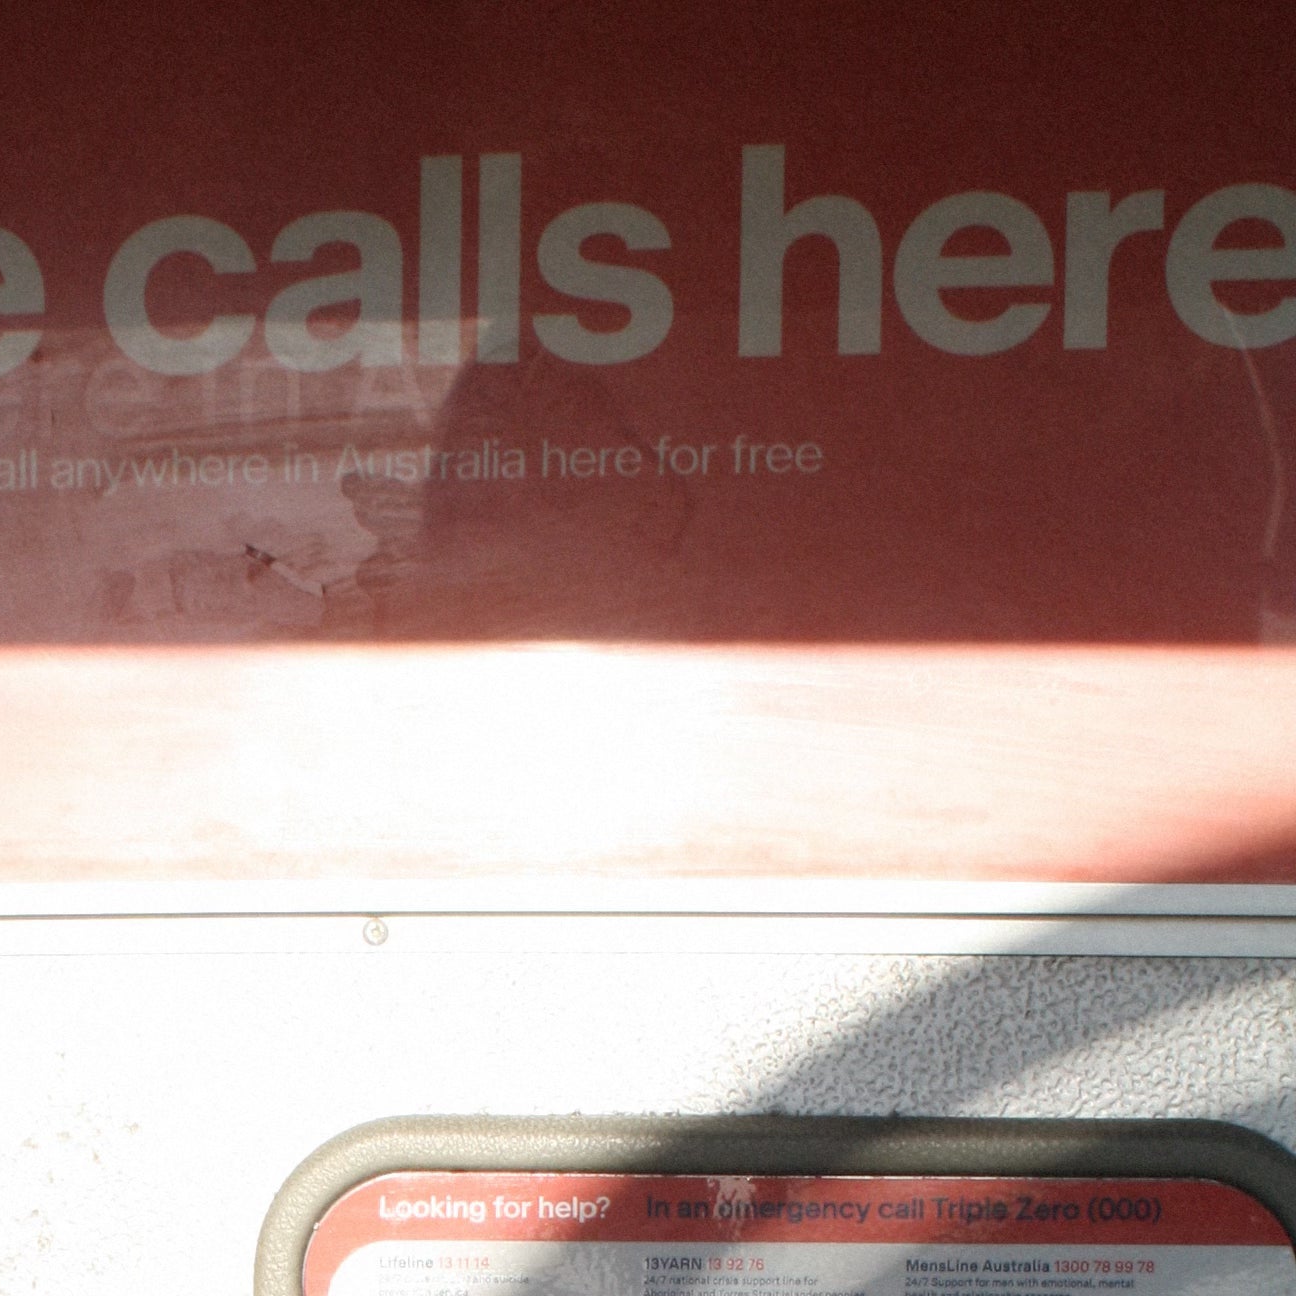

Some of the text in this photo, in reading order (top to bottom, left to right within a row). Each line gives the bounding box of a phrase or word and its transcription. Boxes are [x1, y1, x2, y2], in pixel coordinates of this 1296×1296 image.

[103, 152, 674, 376] calls
[738, 144, 1296, 356] here
[51, 446, 270, 496] anywhere
[283, 444, 319, 484] in
[335, 438, 526, 482] Australia
[542, 438, 642, 478] here
[658, 435, 716, 476] for
[732, 434, 823, 475] free
[379, 1195, 611, 1223] Looking for help?
[646, 1196, 670, 1217] In
[677, 1201, 709, 1217] an
[878, 1198, 924, 1220] call
[932, 1198, 1009, 1223] Triple
[1015, 1198, 1081, 1221] Zero
[1088, 1198, 1162, 1223] (000)
[379, 1256, 490, 1270] Lifeline 13 11 14
[644, 1257, 765, 1271] 13YARN 13 92 76
[905, 1259, 1154, 1273] MensLine Australia 1300 78 99 78
[643, 1276, 818, 1288] 24/7 national crisis support line for
[905, 1277, 1134, 1290] 24/7 Support for men with emotional, mental
